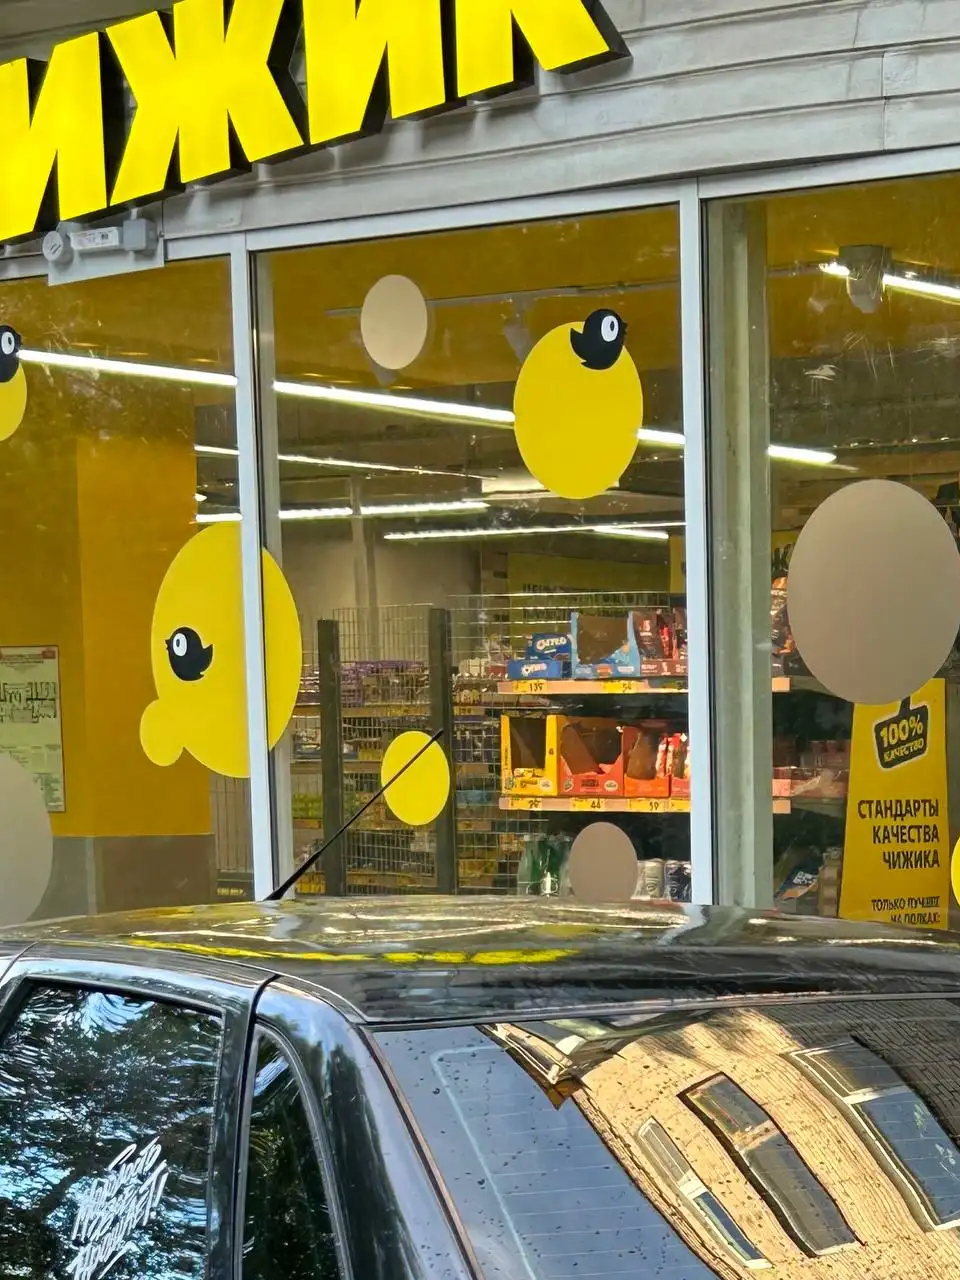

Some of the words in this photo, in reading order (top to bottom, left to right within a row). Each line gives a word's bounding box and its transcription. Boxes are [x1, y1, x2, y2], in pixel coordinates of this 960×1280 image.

[880, 714, 924, 748] 100%
[884, 738, 925, 763] КАЧЕСТВО
[857, 799, 939, 821] СТАНДАРТЫ
[872, 824, 940, 844] КАЧЕСТВА
[883, 850, 940, 869] ЧИЖИКА
[871, 897, 906, 912] ТОЛЬКО
